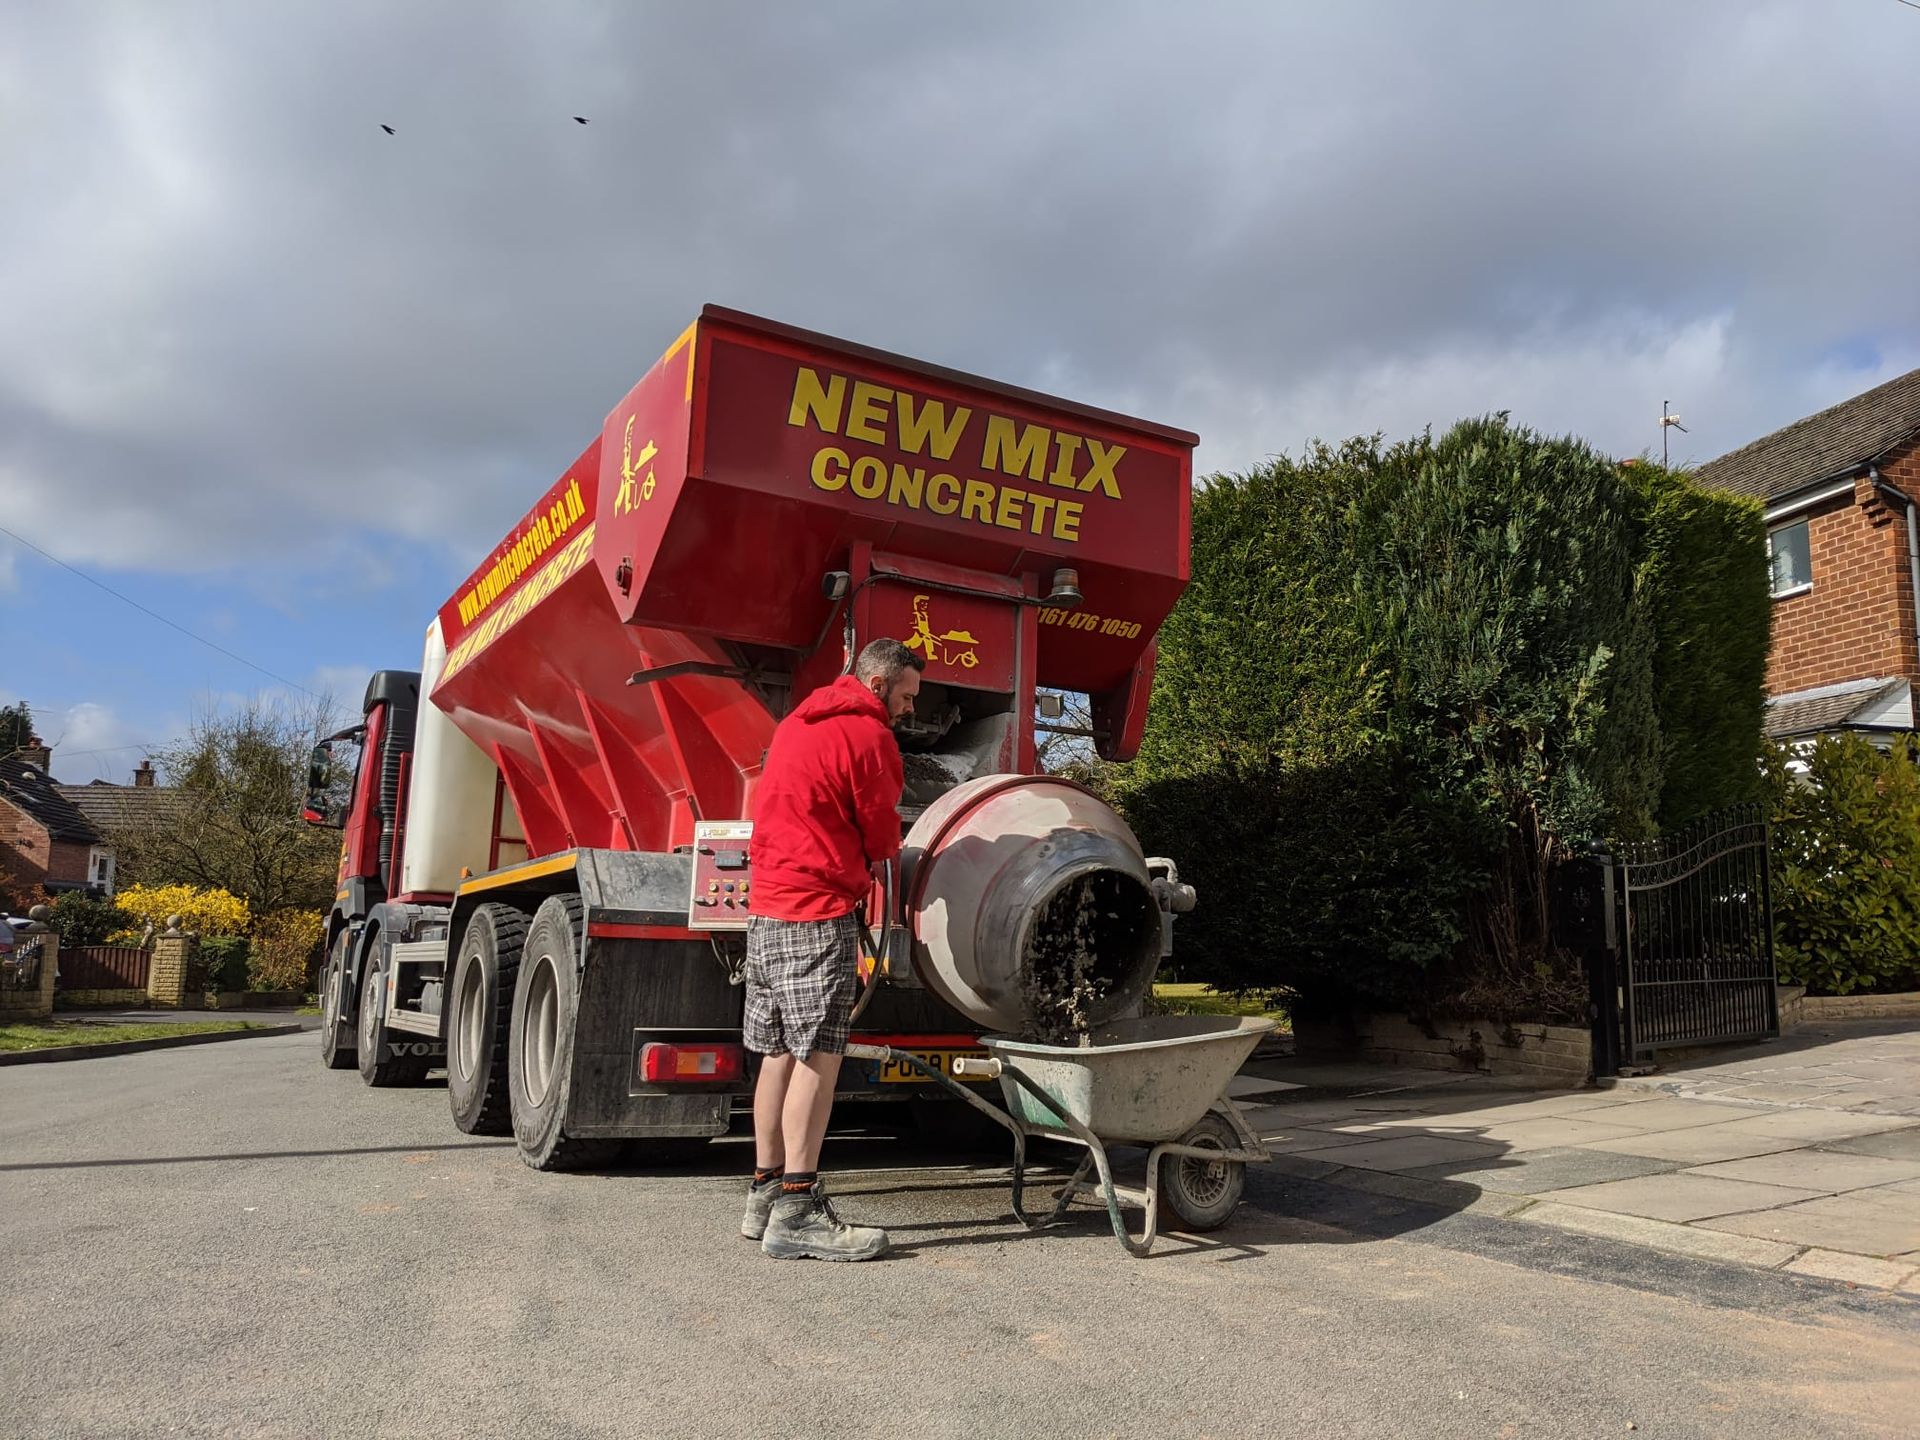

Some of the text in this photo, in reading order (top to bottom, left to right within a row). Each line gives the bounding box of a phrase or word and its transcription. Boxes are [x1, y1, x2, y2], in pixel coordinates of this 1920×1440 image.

[788, 366, 1128, 500] NEW MIX
[810, 447, 1084, 542] CONCRETE
[440, 630, 481, 684] NEW
[501, 525, 596, 632] CONCRETE
[458, 478, 586, 628] www.newmixconcrete.co.uk
[1066, 611, 1101, 632] 476
[1099, 617, 1142, 639] 1050
[387, 1042, 448, 1058] VOL
